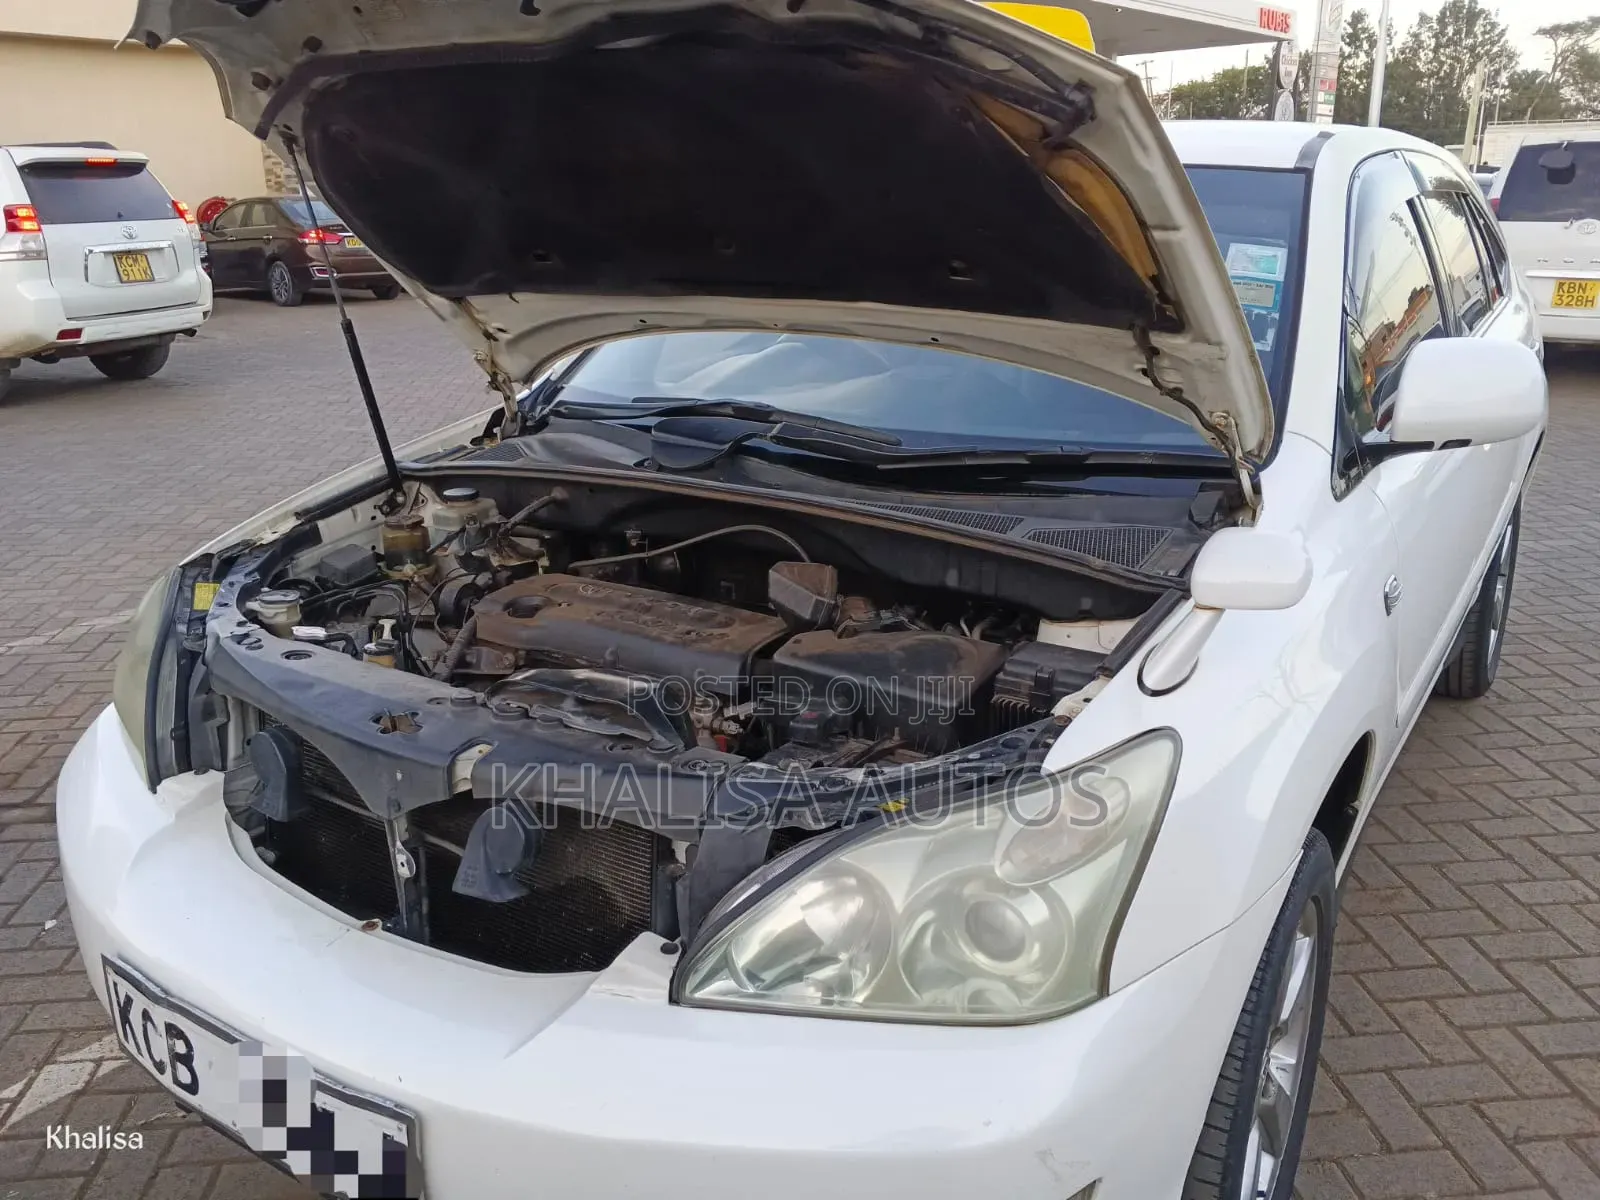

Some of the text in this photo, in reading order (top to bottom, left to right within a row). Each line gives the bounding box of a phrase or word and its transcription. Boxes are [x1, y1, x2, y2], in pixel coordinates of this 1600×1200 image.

[117, 255, 142, 269] KCM
[122, 267, 152, 281] 911K
[1557, 281, 1588, 294] KBN
[1554, 294, 1595, 308] 328H
[113, 980, 200, 1096] KCB
